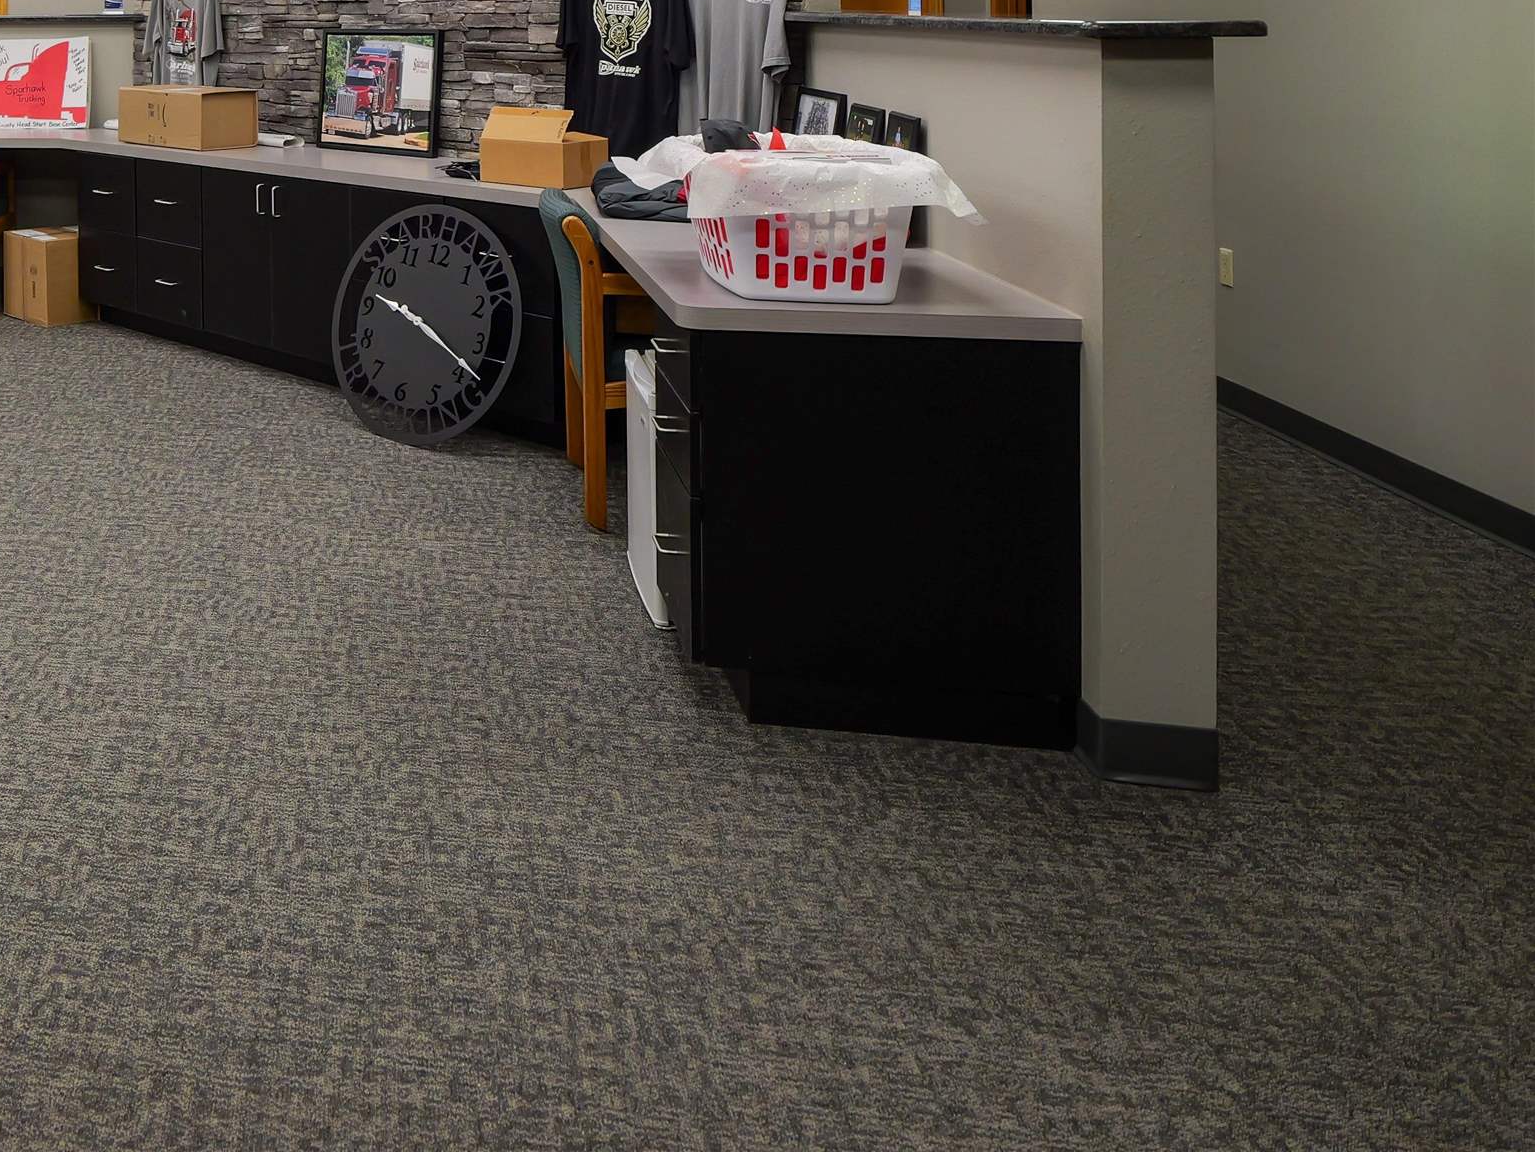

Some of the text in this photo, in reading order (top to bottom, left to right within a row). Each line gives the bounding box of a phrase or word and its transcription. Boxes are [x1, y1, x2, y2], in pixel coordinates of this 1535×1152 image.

[5, 82, 46, 95] Sparhawk
[18, 95, 46, 105] Trucking
[400, 246, 420, 268] 11
[428, 242, 450, 268] 12
[376, 266, 397, 288] 10
[460, 264, 473, 286] 1
[361, 296, 375, 316] 9
[471, 295, 486, 318] 2
[360, 327, 374, 349] 8
[472, 332, 485, 355] 3
[370, 359, 386, 380] 7
[394, 382, 409, 402] 6
[425, 384, 442, 405] 5
